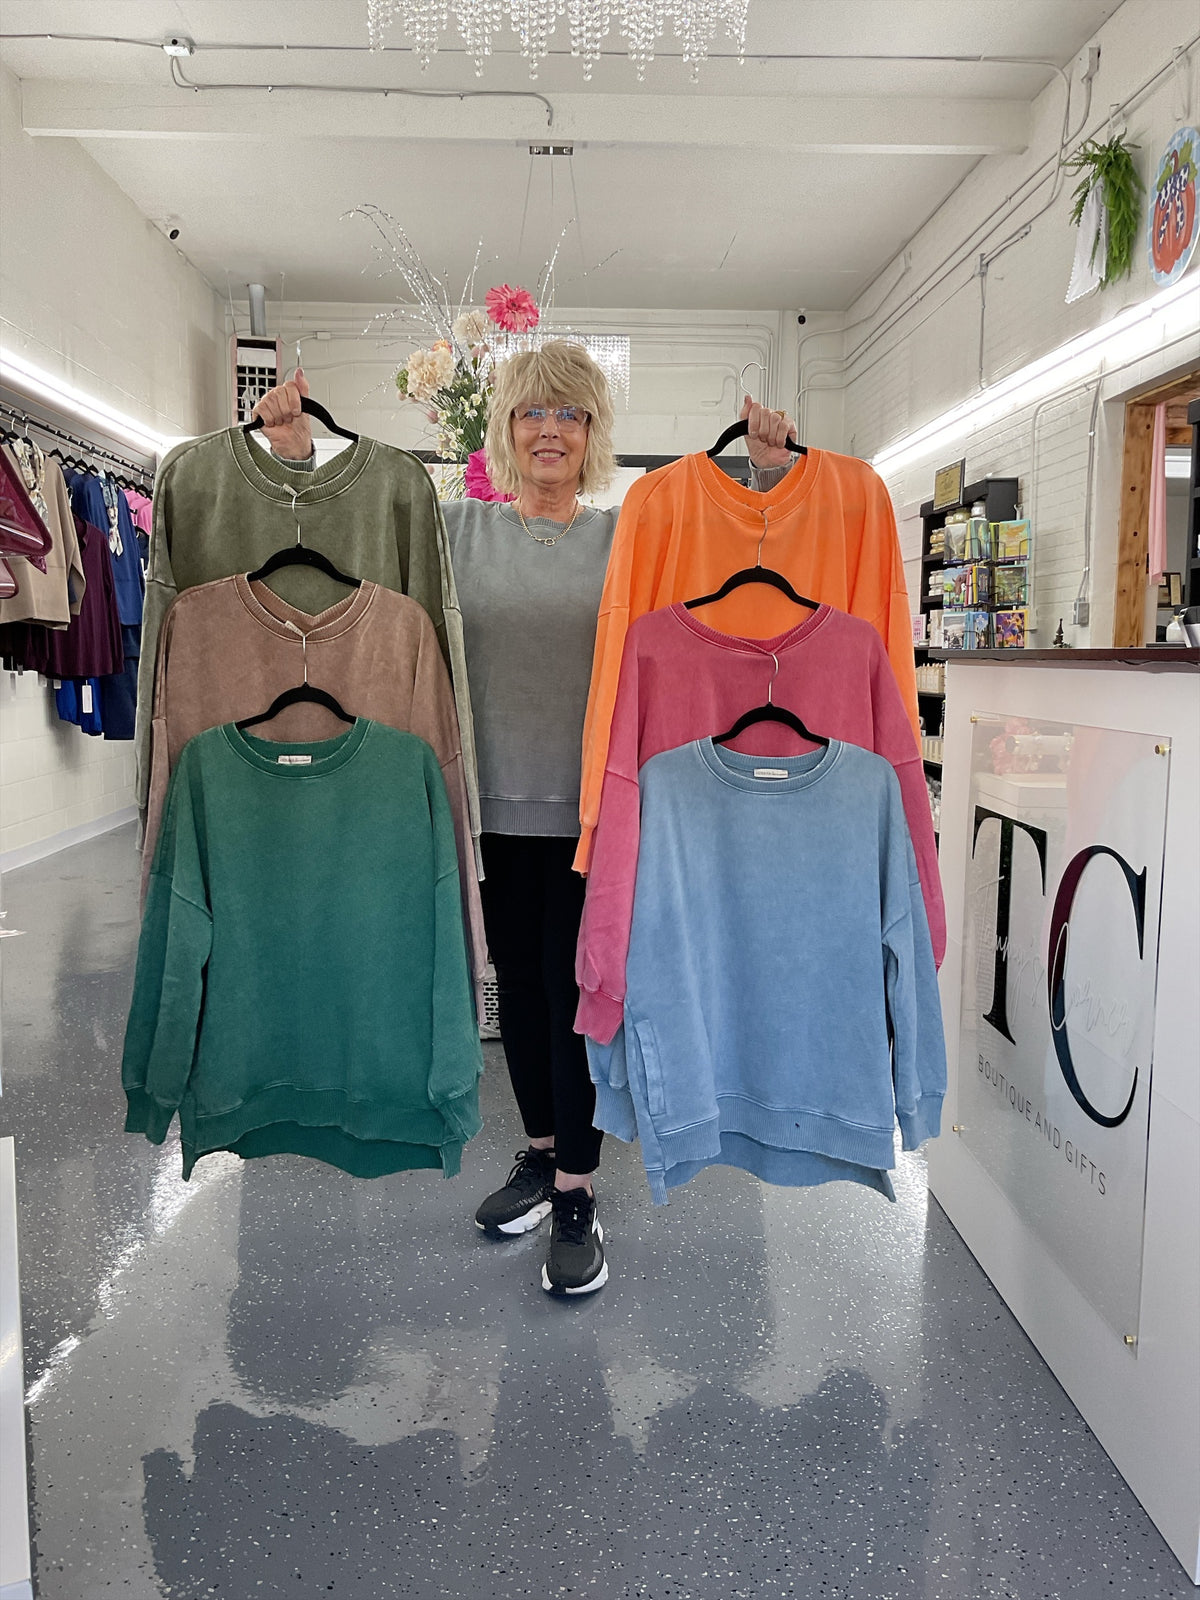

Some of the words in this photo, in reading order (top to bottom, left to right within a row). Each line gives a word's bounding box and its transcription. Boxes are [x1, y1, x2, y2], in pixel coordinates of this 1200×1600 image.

[978, 1054, 1032, 1122] BOUTIQUE
[1034, 1111, 1061, 1149] AND
[1065, 1140, 1106, 1195] GIFTS
